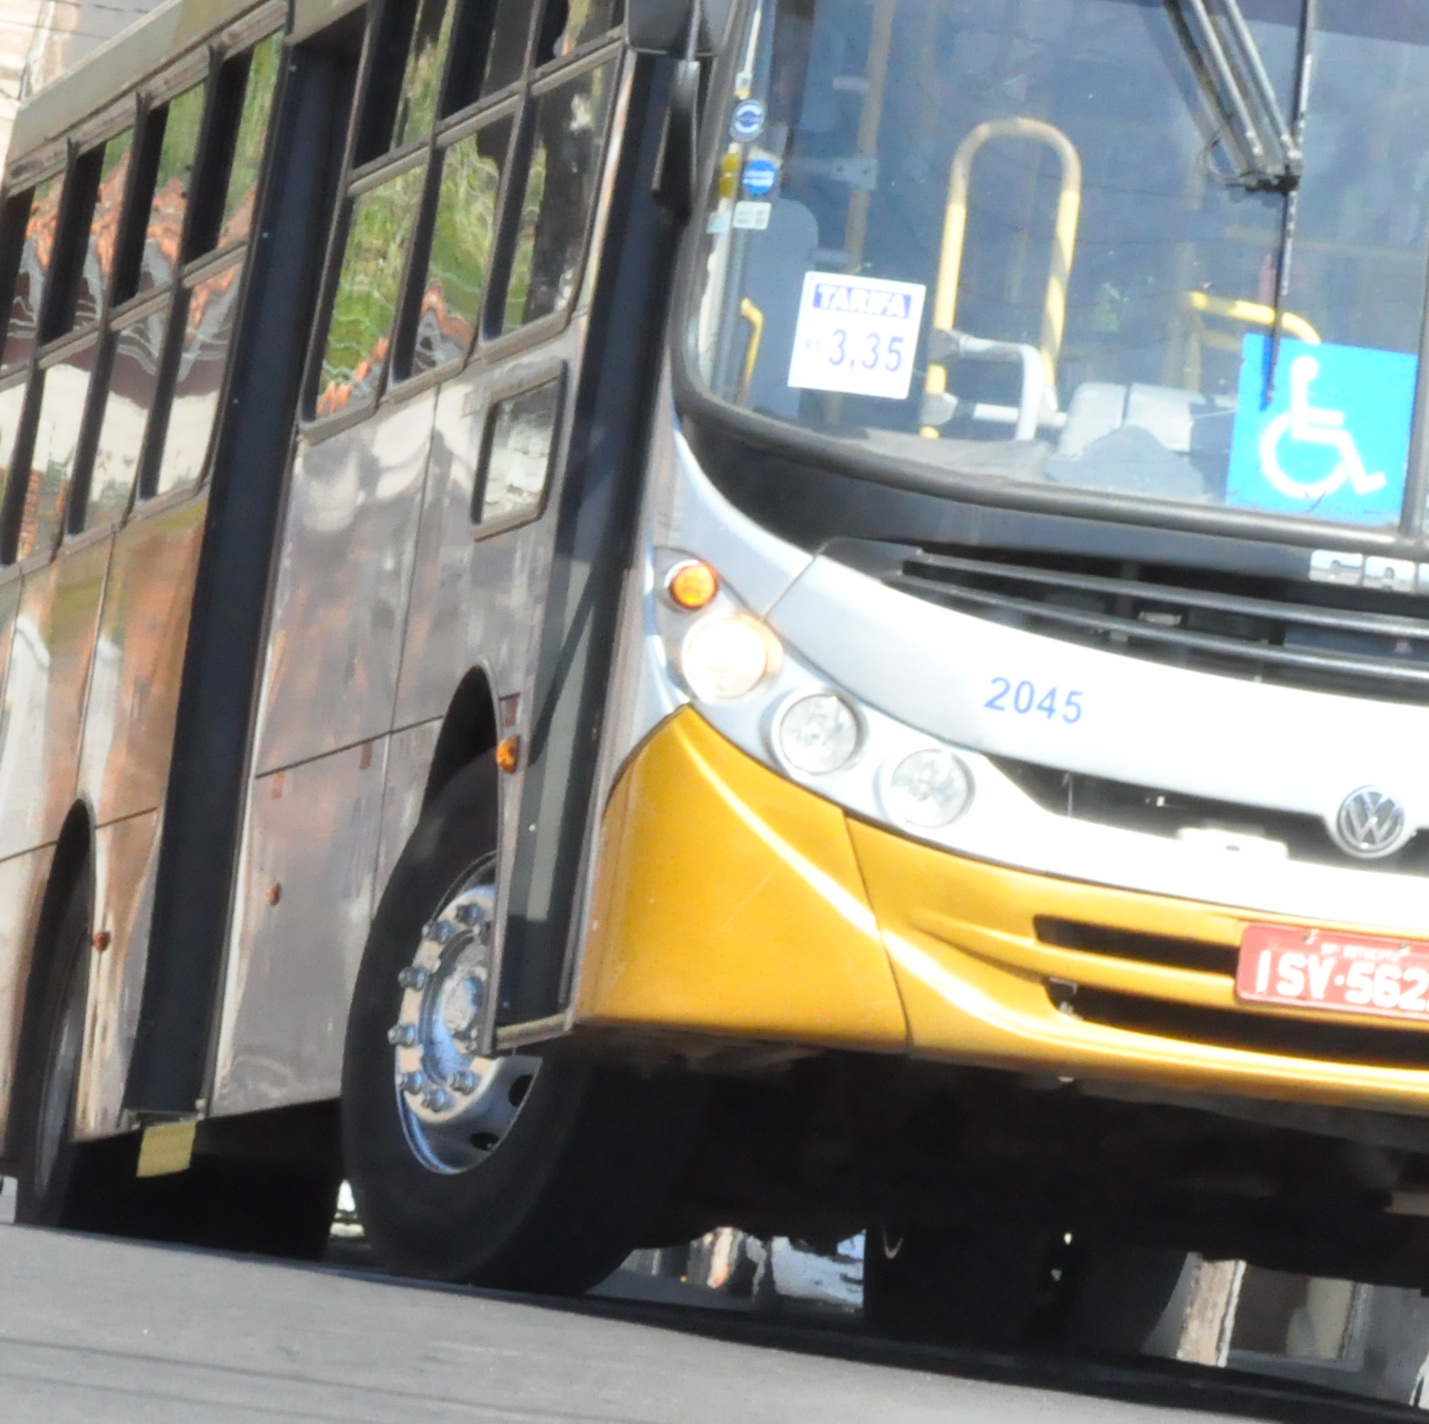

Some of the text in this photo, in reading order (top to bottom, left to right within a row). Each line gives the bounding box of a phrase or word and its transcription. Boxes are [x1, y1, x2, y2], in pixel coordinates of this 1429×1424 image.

[815, 284, 908, 318] TARIFA
[828, 328, 904, 375] 3,35
[985, 677, 1083, 724] 2045
